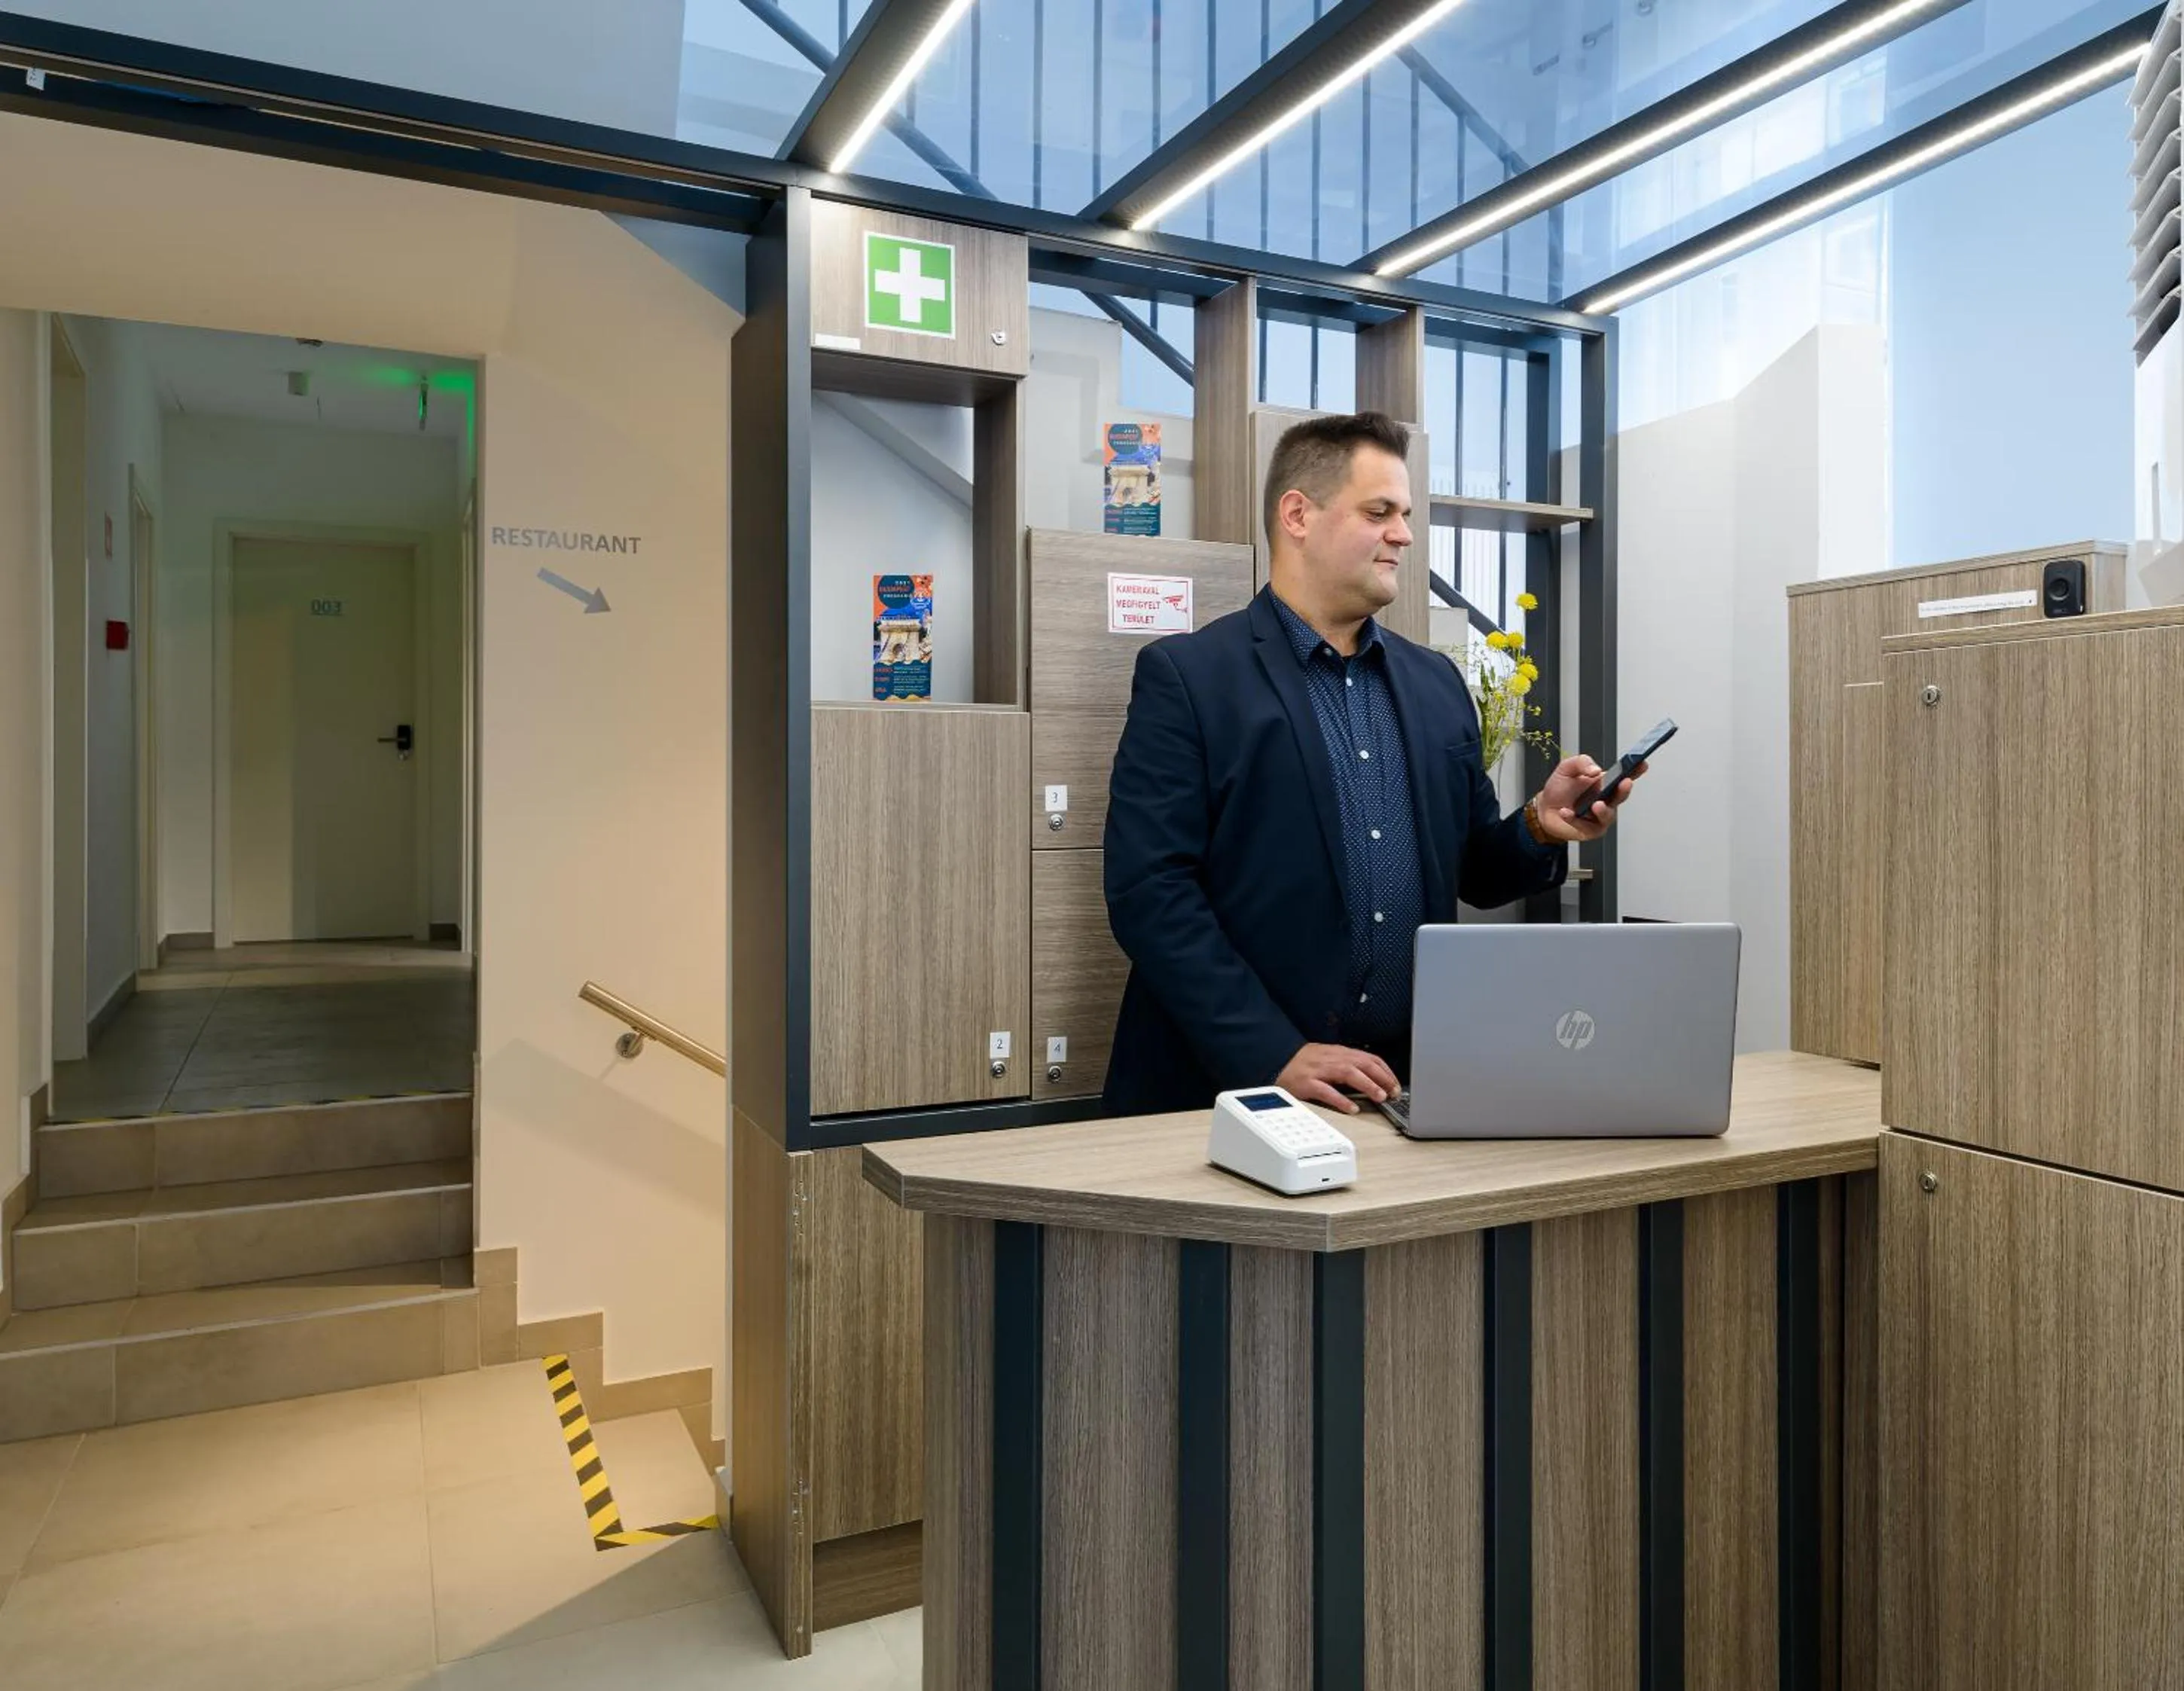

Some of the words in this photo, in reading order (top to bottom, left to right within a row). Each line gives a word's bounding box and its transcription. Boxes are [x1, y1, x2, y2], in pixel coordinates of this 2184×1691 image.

[492, 527, 642, 554] RESTAURANT
[996, 1039, 1004, 1049] 2
[1054, 1042, 1061, 1052] 4
